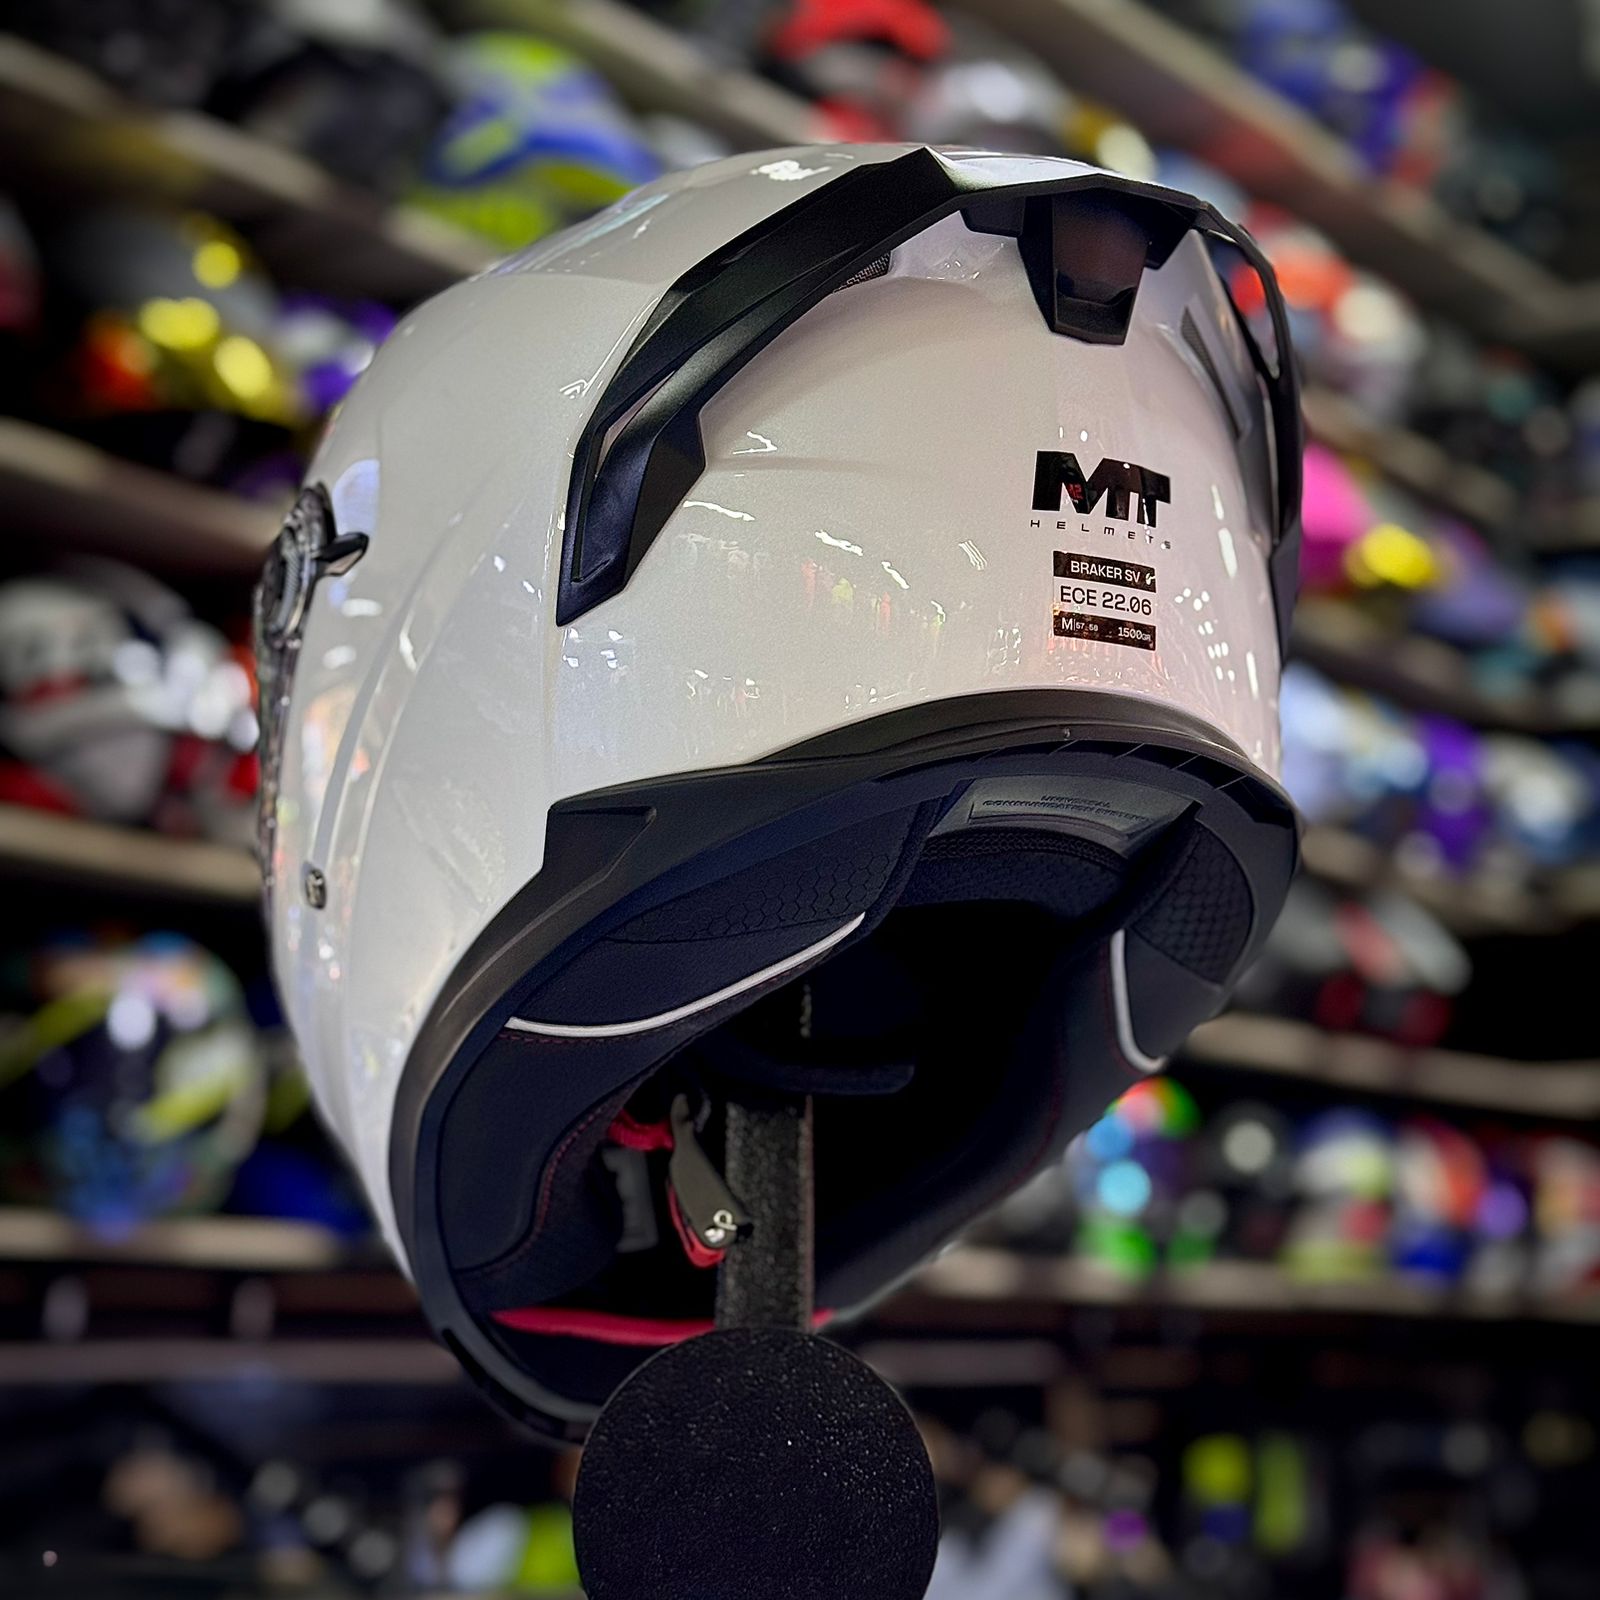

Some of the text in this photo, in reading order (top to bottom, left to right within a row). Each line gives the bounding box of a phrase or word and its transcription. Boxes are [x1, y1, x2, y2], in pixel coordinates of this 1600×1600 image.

[1032, 450, 1171, 528] MT
[1030, 519, 1171, 550] HELMETS
[1070, 560, 1140, 583] BRAKER SV
[1060, 585, 1152, 616] ECE 22.06
[1061, 617, 1073, 631] M
